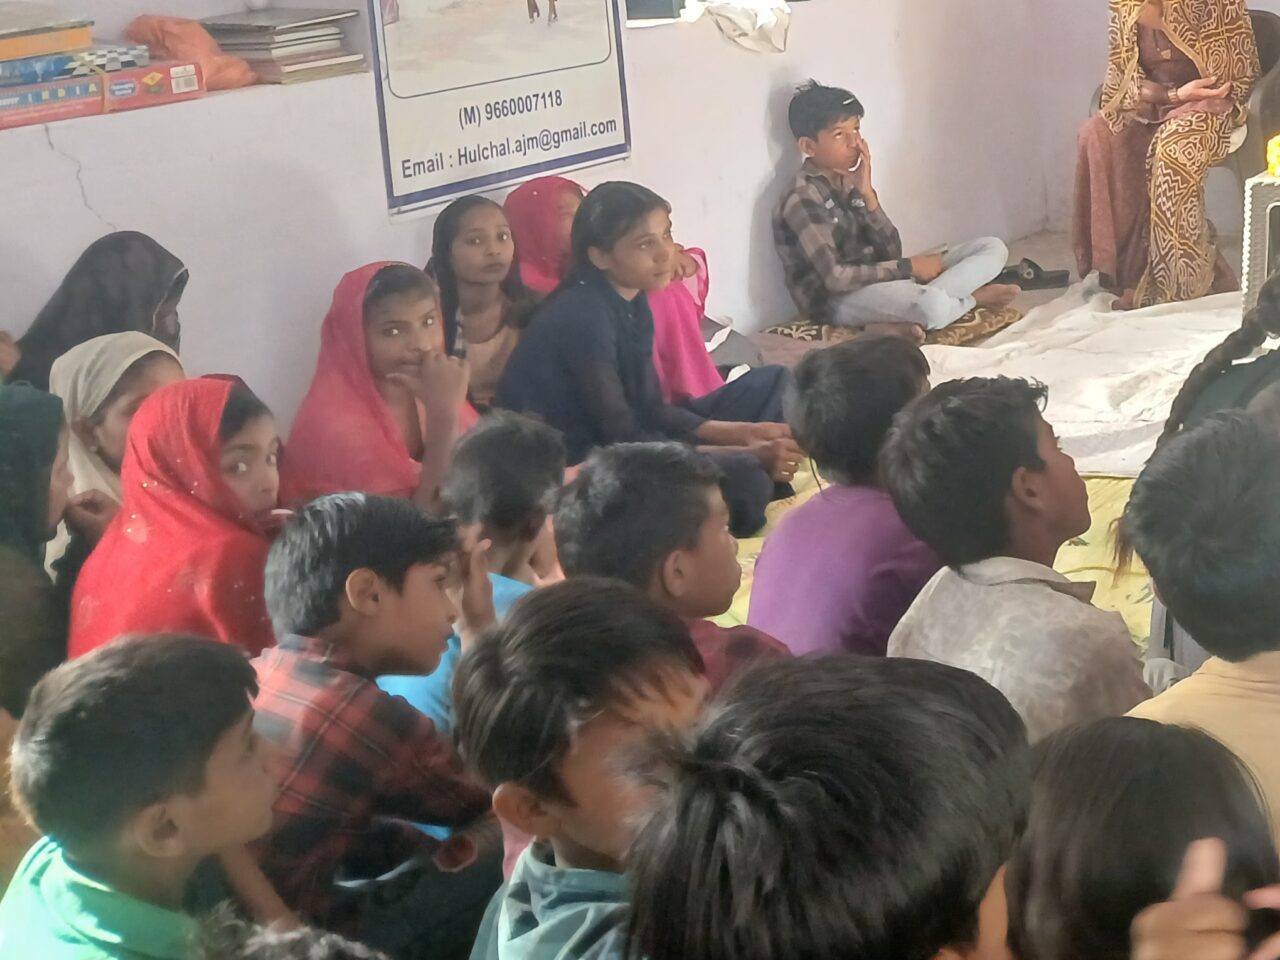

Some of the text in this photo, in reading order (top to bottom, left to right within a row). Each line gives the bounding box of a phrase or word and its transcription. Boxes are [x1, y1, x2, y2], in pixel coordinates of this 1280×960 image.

[459, 89, 562, 130] (M) 9660007118
[402, 117, 617, 179] Email Hulchal.ajm@gmail.com
